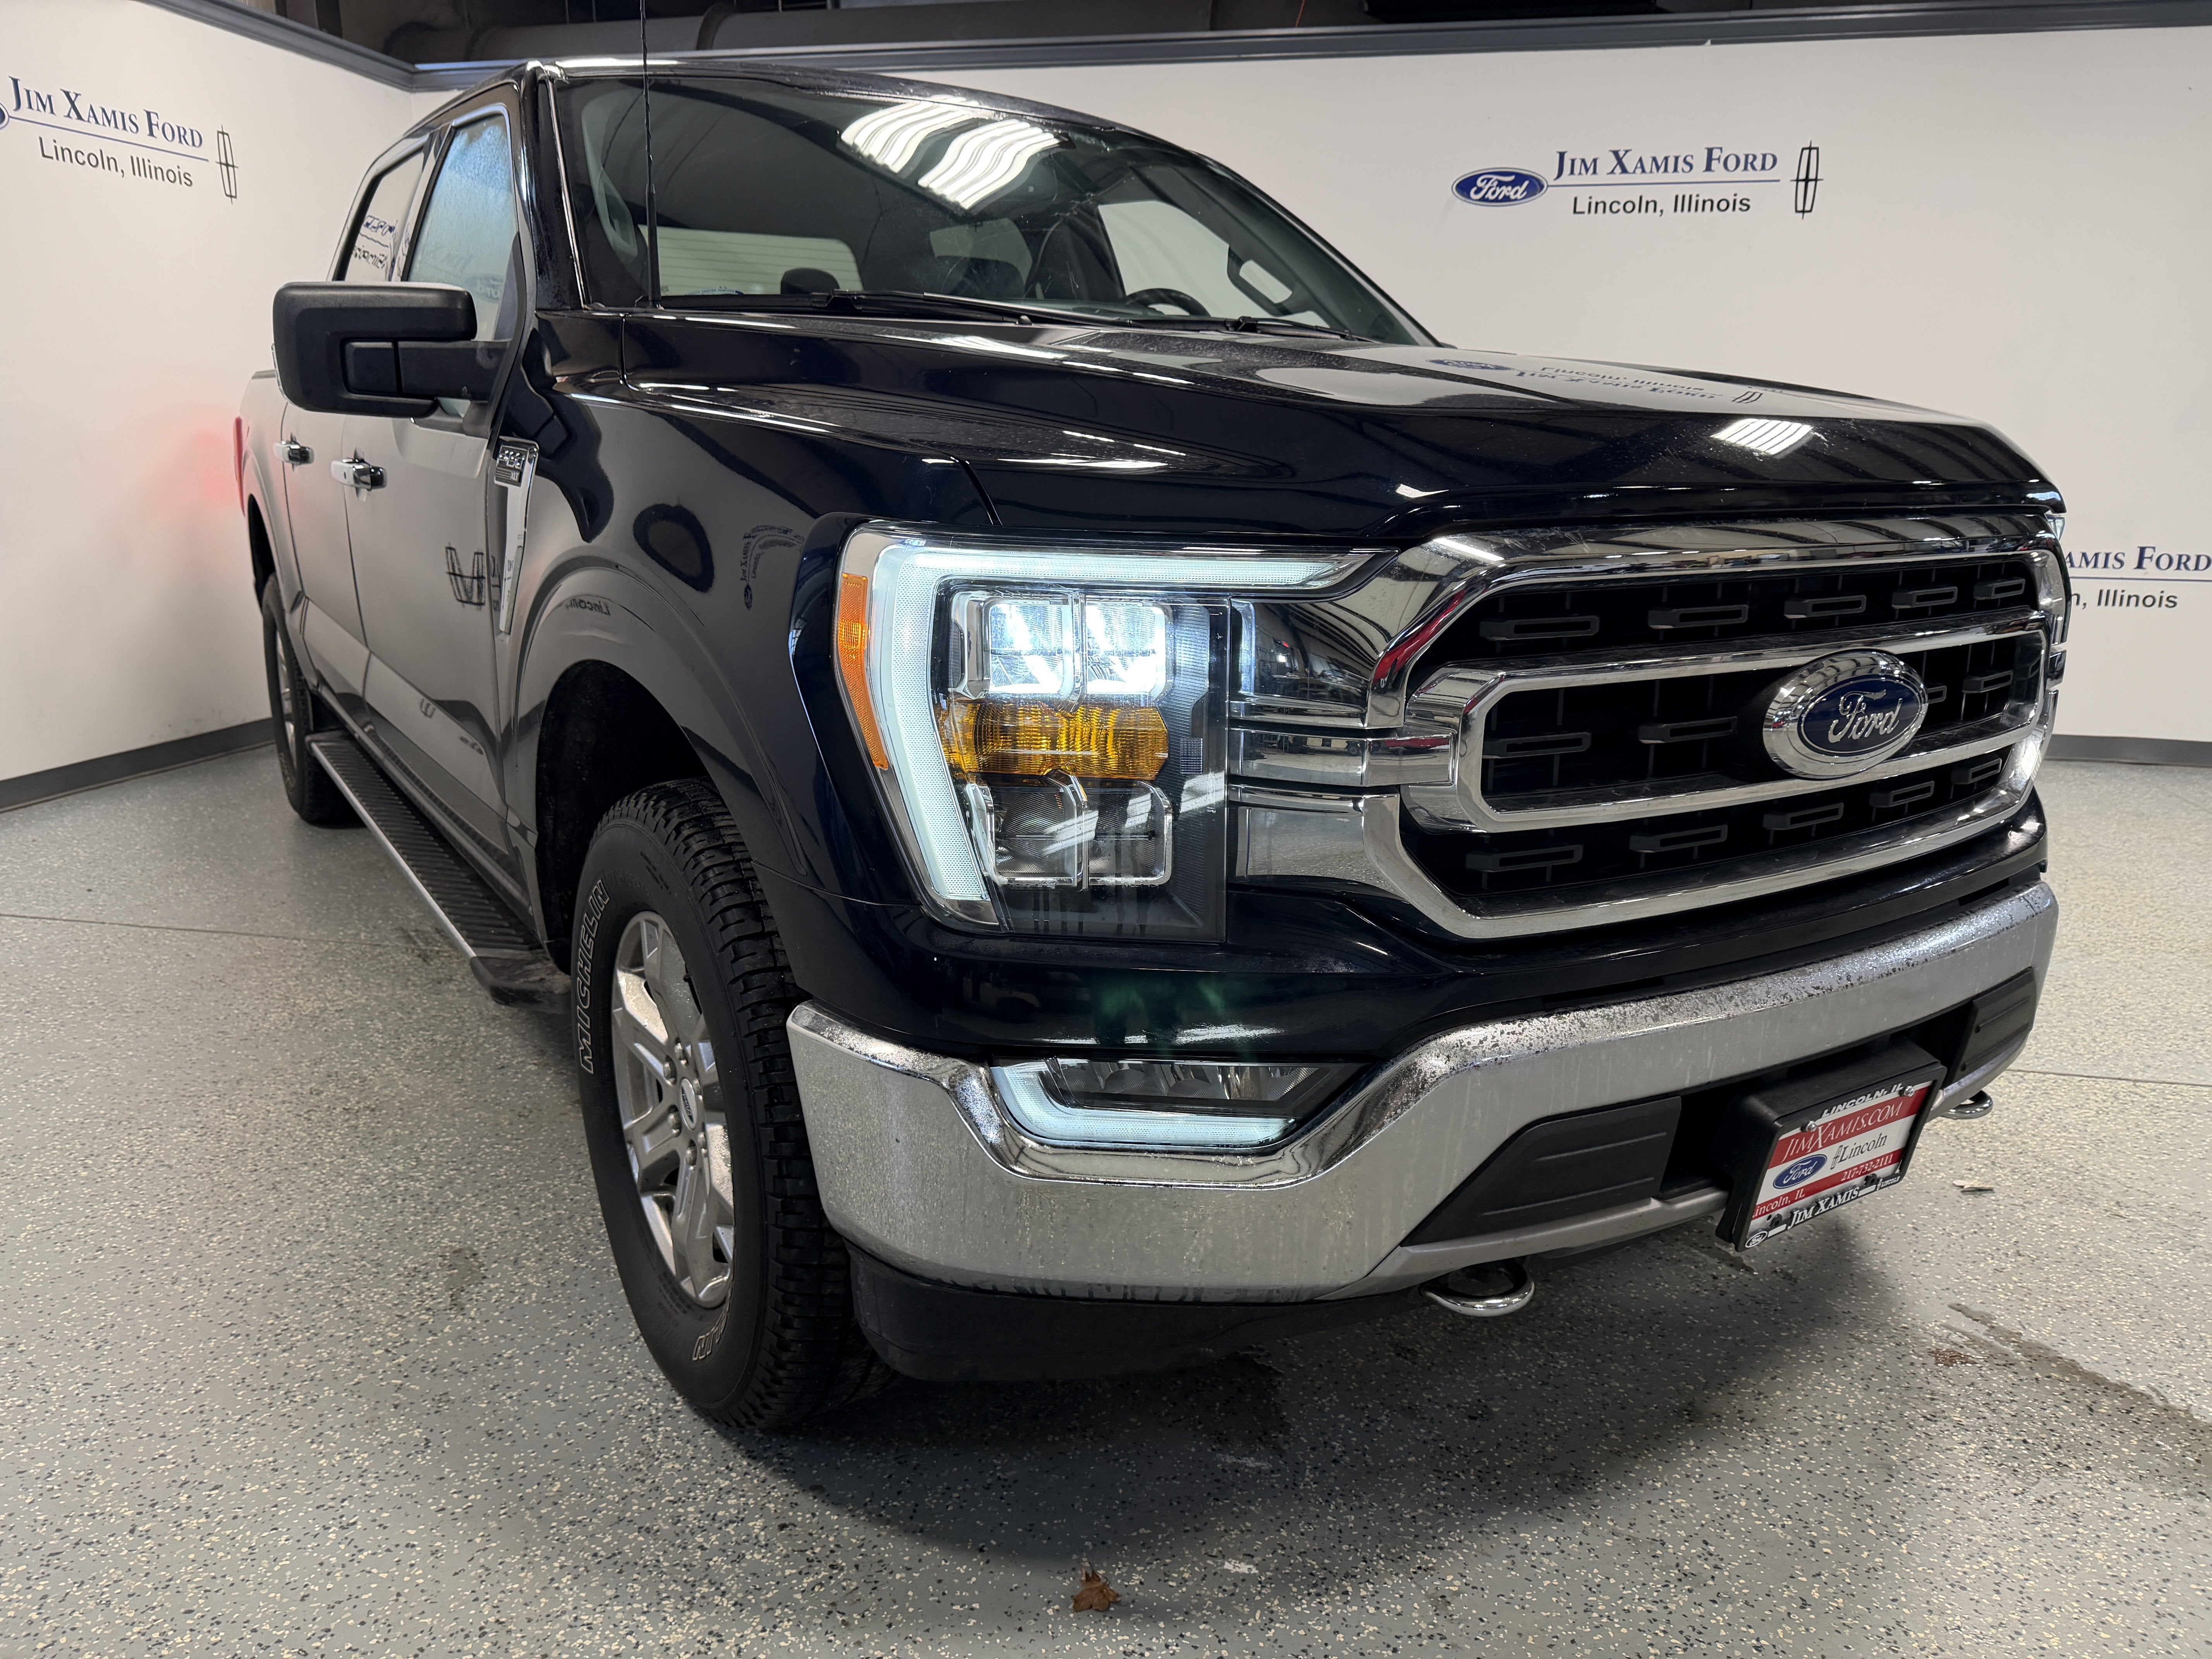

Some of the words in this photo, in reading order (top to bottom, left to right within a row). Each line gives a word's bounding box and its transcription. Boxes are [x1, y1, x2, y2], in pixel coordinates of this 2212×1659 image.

[9, 76, 57, 116] JIM
[60, 88, 139, 134] XAMIS
[143, 109, 203, 148] FORD
[39, 136, 125, 177] Lincoln,
[131, 155, 193, 187] Illinois
[1553, 151, 1599, 181] JIM
[1606, 149, 1694, 175] XAMIS
[1702, 147, 1778, 173] FORD
[1470, 174, 1530, 200] Ford
[1573, 195, 1664, 217] Lincoln,
[1673, 193, 1751, 213] Illinois
[2065, 551, 2125, 569] AMIS
[2133, 546, 2212, 571] FORD
[2097, 589, 2178, 609] Illinois
[1828, 689, 1903, 743] Ford
[576, 879, 611, 1075] MICHELIN
[1822, 1089, 1887, 1118] LINCOLN,
[1891, 1083, 1904, 1093] IL
[1781, 1101, 1903, 1164] JIMXAMIS.COM
[1838, 1133, 1887, 1164] Lincoln
[1783, 1160, 1818, 1184] Ford
[1841, 1154, 1893, 1181] 217-732-2111
[1787, 1206, 1815, 1230] JIM
[1815, 1187, 1859, 1215] XAMIS
[1795, 1188, 1805, 1200] IL
